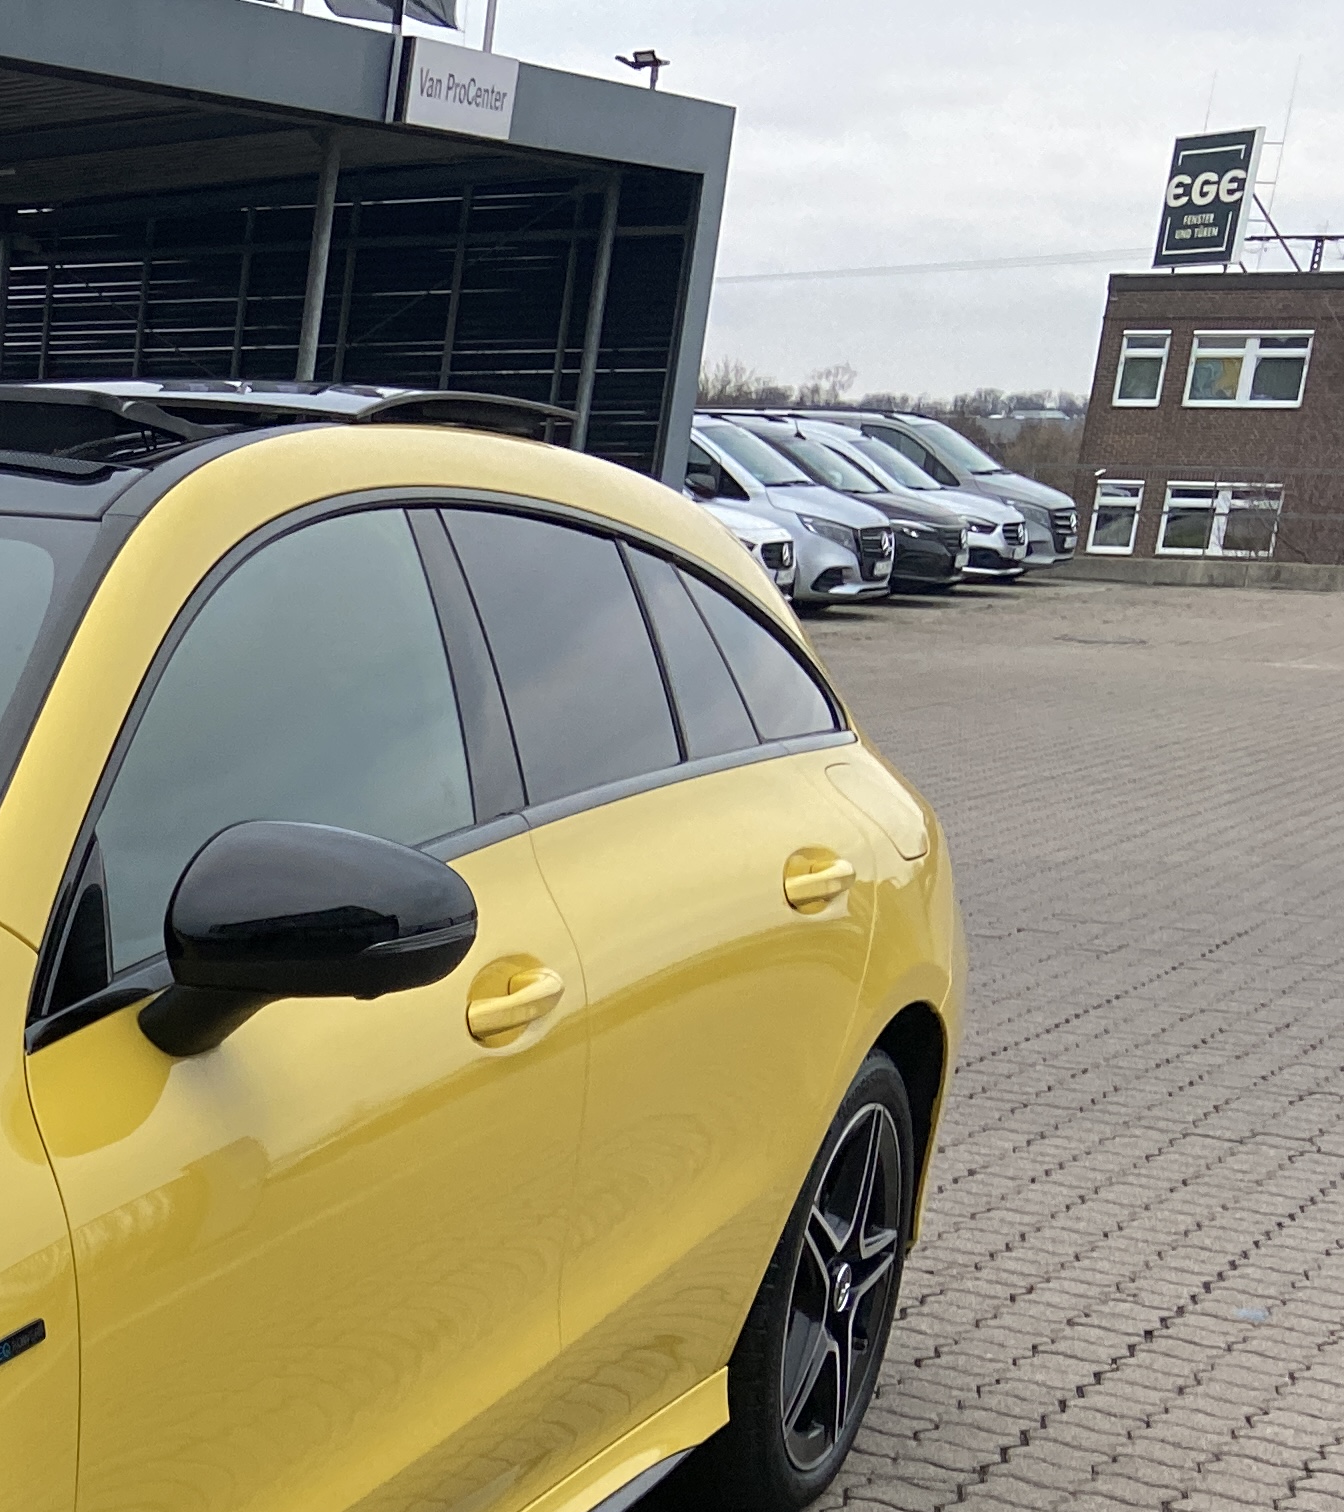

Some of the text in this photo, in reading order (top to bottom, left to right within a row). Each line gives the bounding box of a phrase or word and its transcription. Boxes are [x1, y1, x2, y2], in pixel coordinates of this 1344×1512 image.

[419, 67, 508, 112] Van ProCenter
[1183, 213, 1215, 225] FENSTER
[1175, 225, 1219, 239] UND TÜREN
